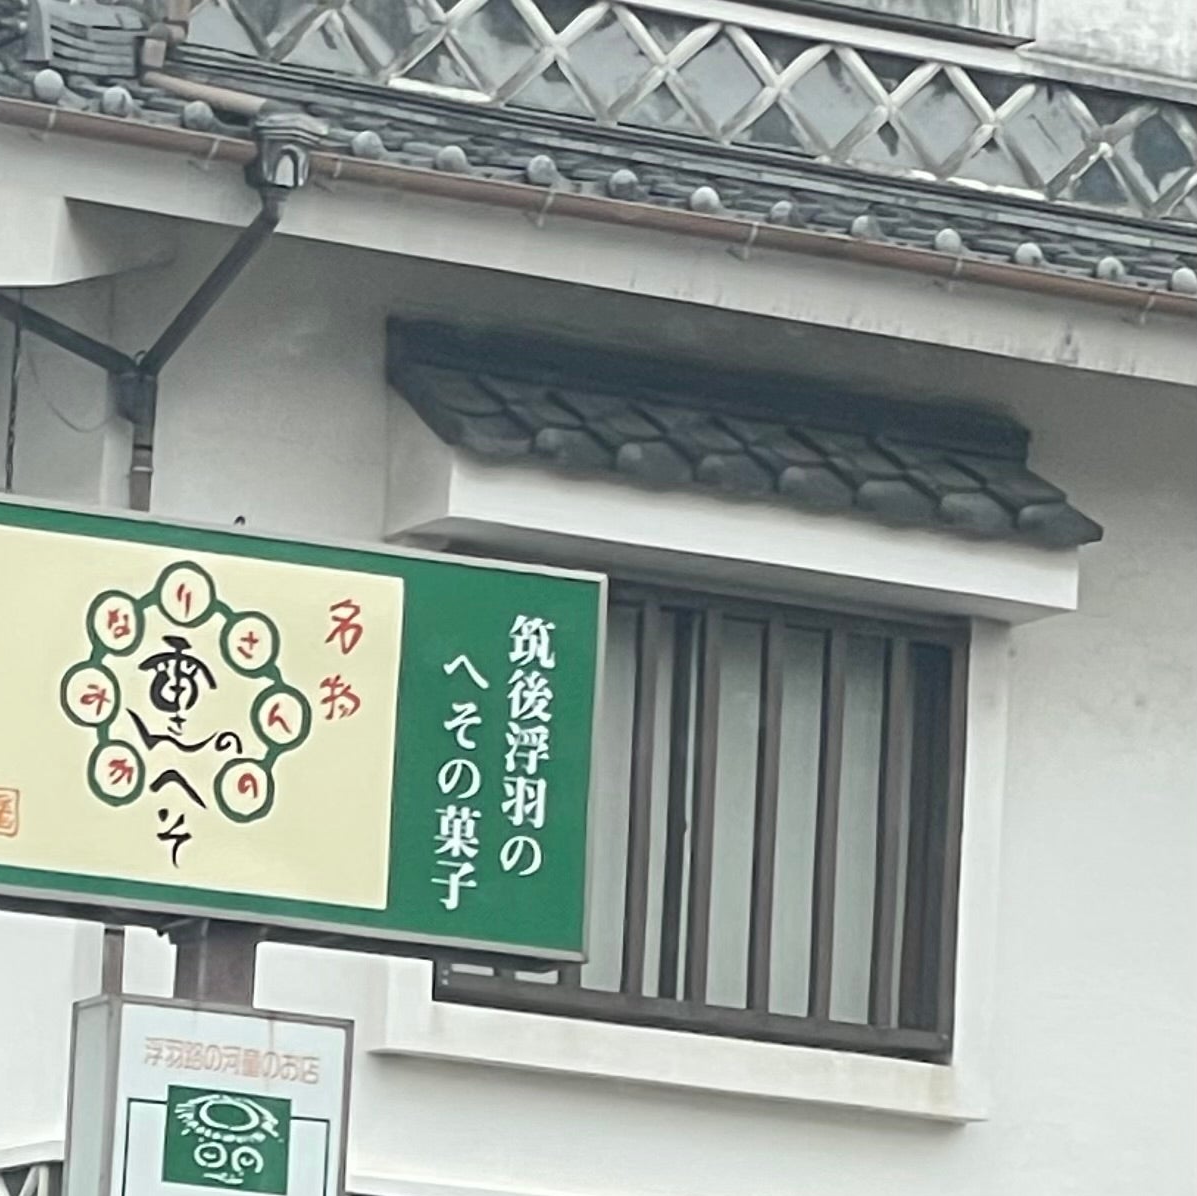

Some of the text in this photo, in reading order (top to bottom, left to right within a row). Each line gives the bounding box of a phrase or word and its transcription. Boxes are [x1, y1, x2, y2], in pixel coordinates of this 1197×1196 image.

[320, 598, 364, 722] 名物
[431, 652, 490, 911] へその菓子
[501, 614, 556, 877] 筑後浮羽の
